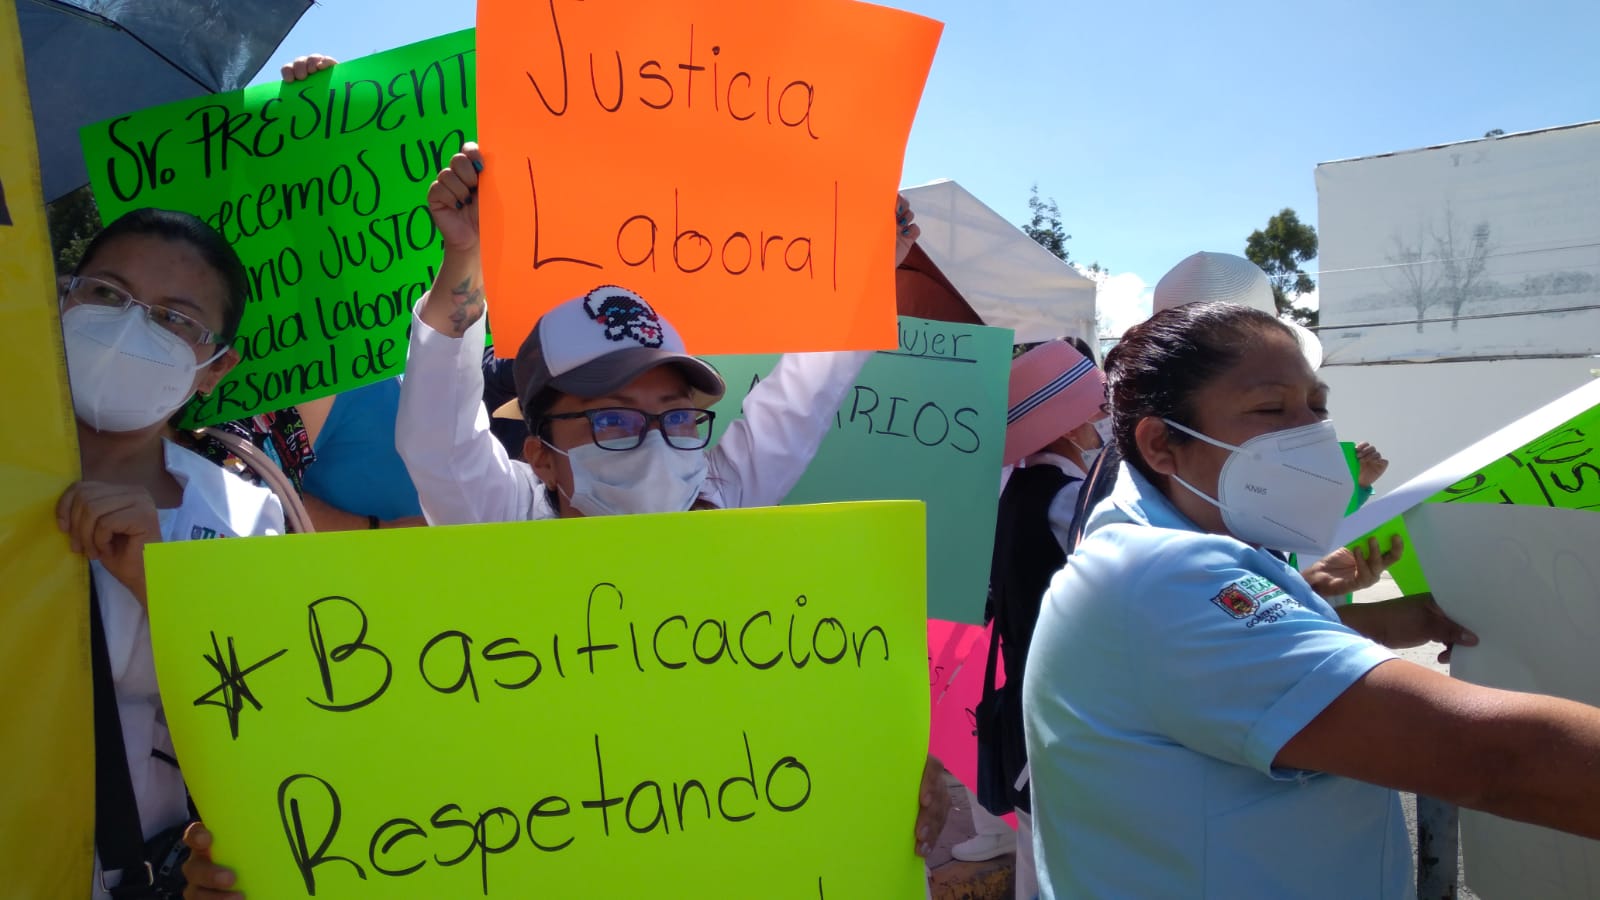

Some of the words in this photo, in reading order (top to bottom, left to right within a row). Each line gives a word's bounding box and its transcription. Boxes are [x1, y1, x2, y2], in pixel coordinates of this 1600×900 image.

[107, 115, 175, 202] Sr.
[185, 48, 476, 179] PRESIDENT
[526, 0, 819, 140] Justicia
[206, 148, 381, 247] ecemos
[527, 156, 838, 293] Laboral
[351, 337, 399, 379] de
[896, 320, 972, 358] ujer
[276, 730, 813, 897] Respetando
